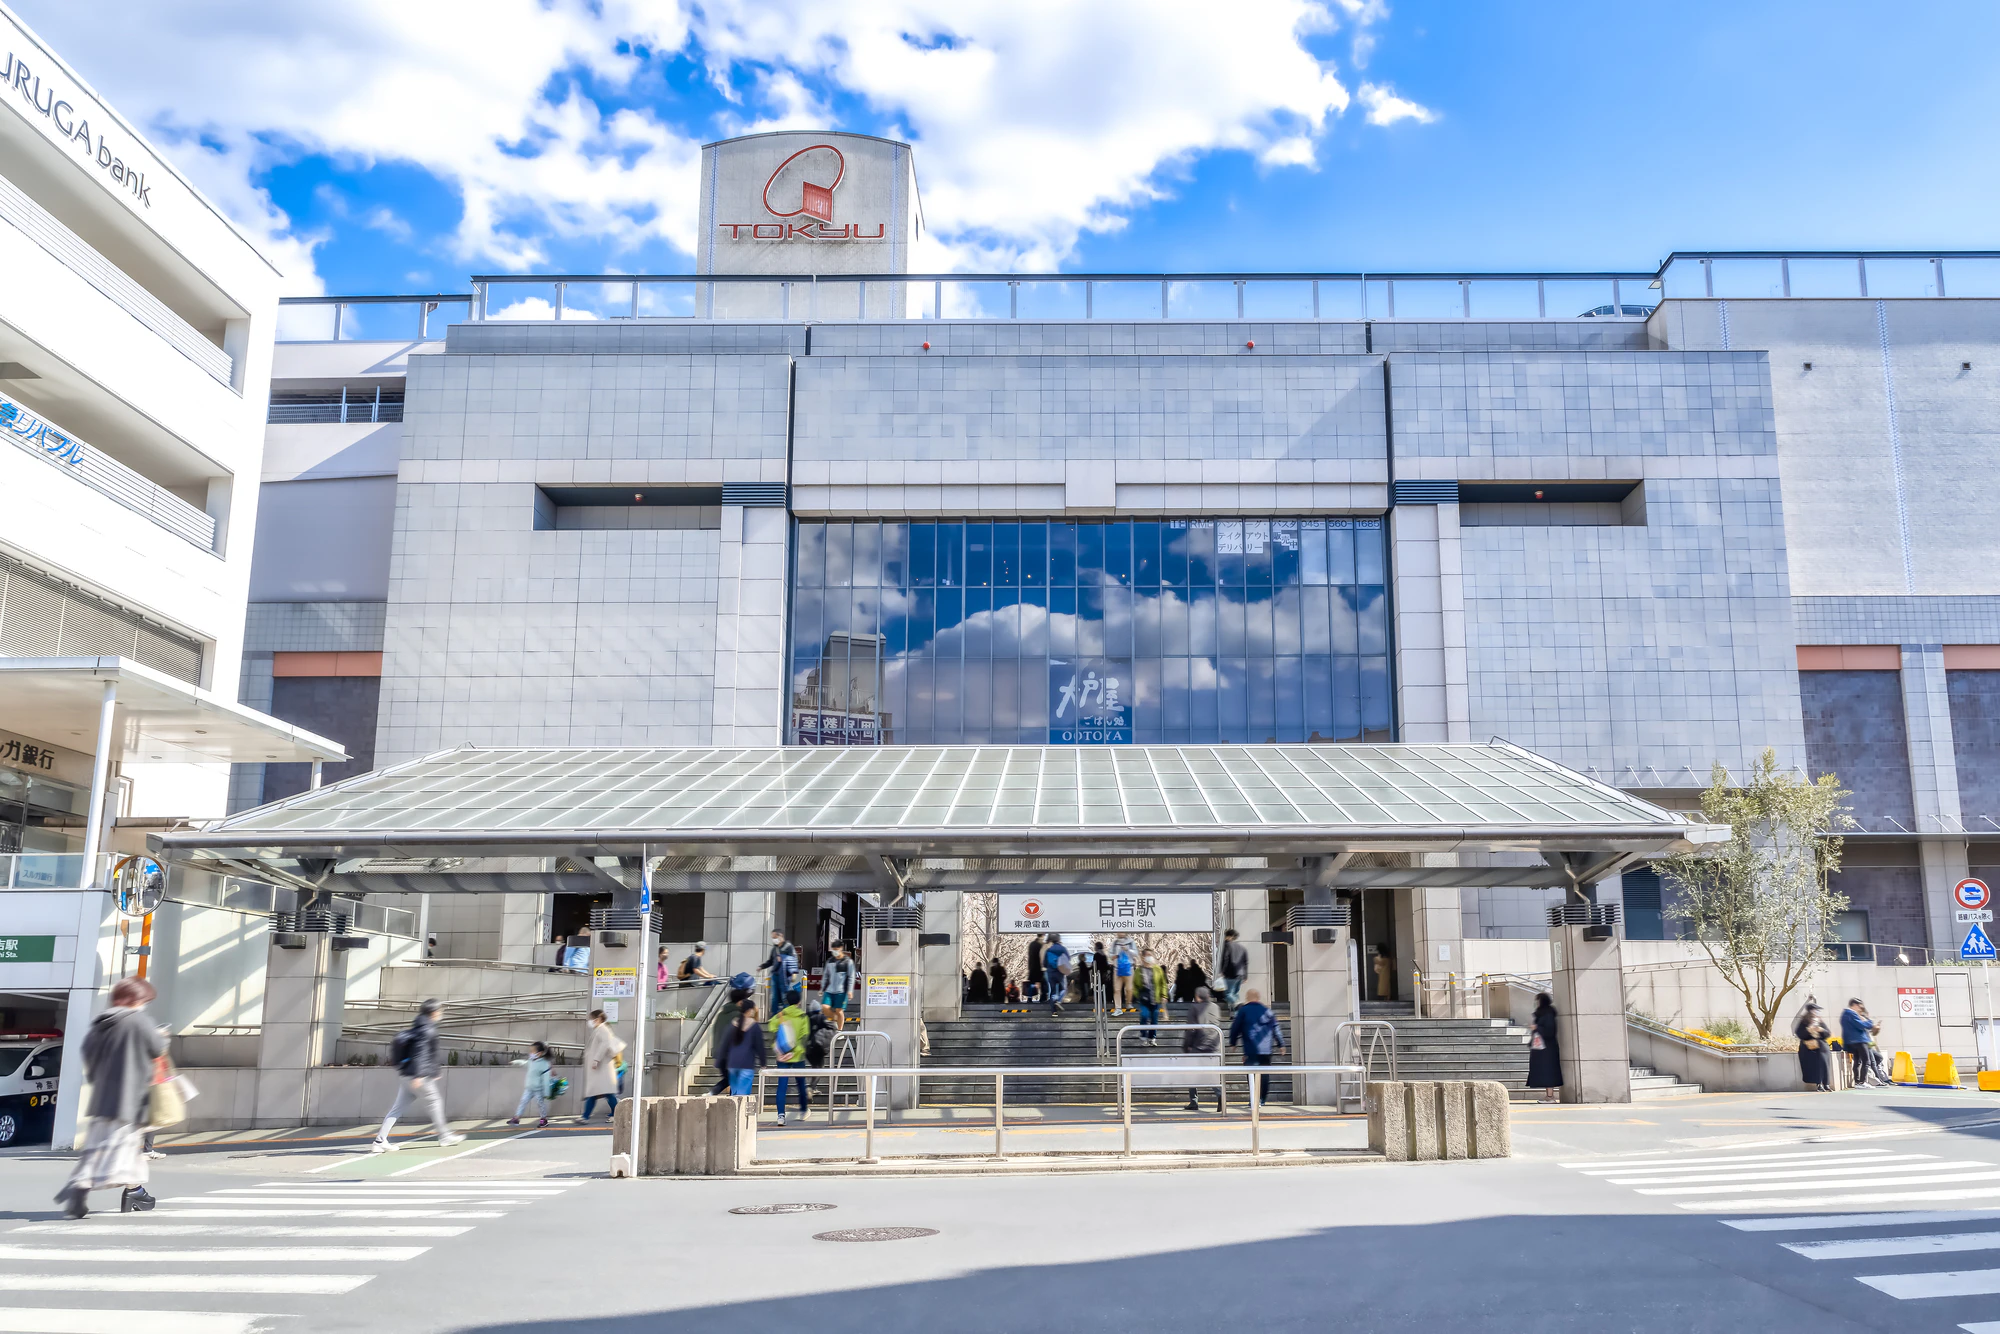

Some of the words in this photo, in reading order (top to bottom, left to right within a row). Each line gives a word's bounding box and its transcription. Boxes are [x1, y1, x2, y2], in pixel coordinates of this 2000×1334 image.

[96, 135, 151, 208] bank
[719, 223, 885, 241] TOKYU
[1218, 532, 1269, 540] テイクアウト
[1218, 543, 1263, 552] デリバリー
[1056, 671, 1125, 718] 大戸屋
[1062, 730, 1123, 741] OOTOYA
[1098, 898, 1156, 918] 日吉駅
[1014, 920, 1050, 929] 東急電鉄
[1101, 919, 1135, 930] Hiyoshi
[1137, 919, 1156, 928] Sta.
